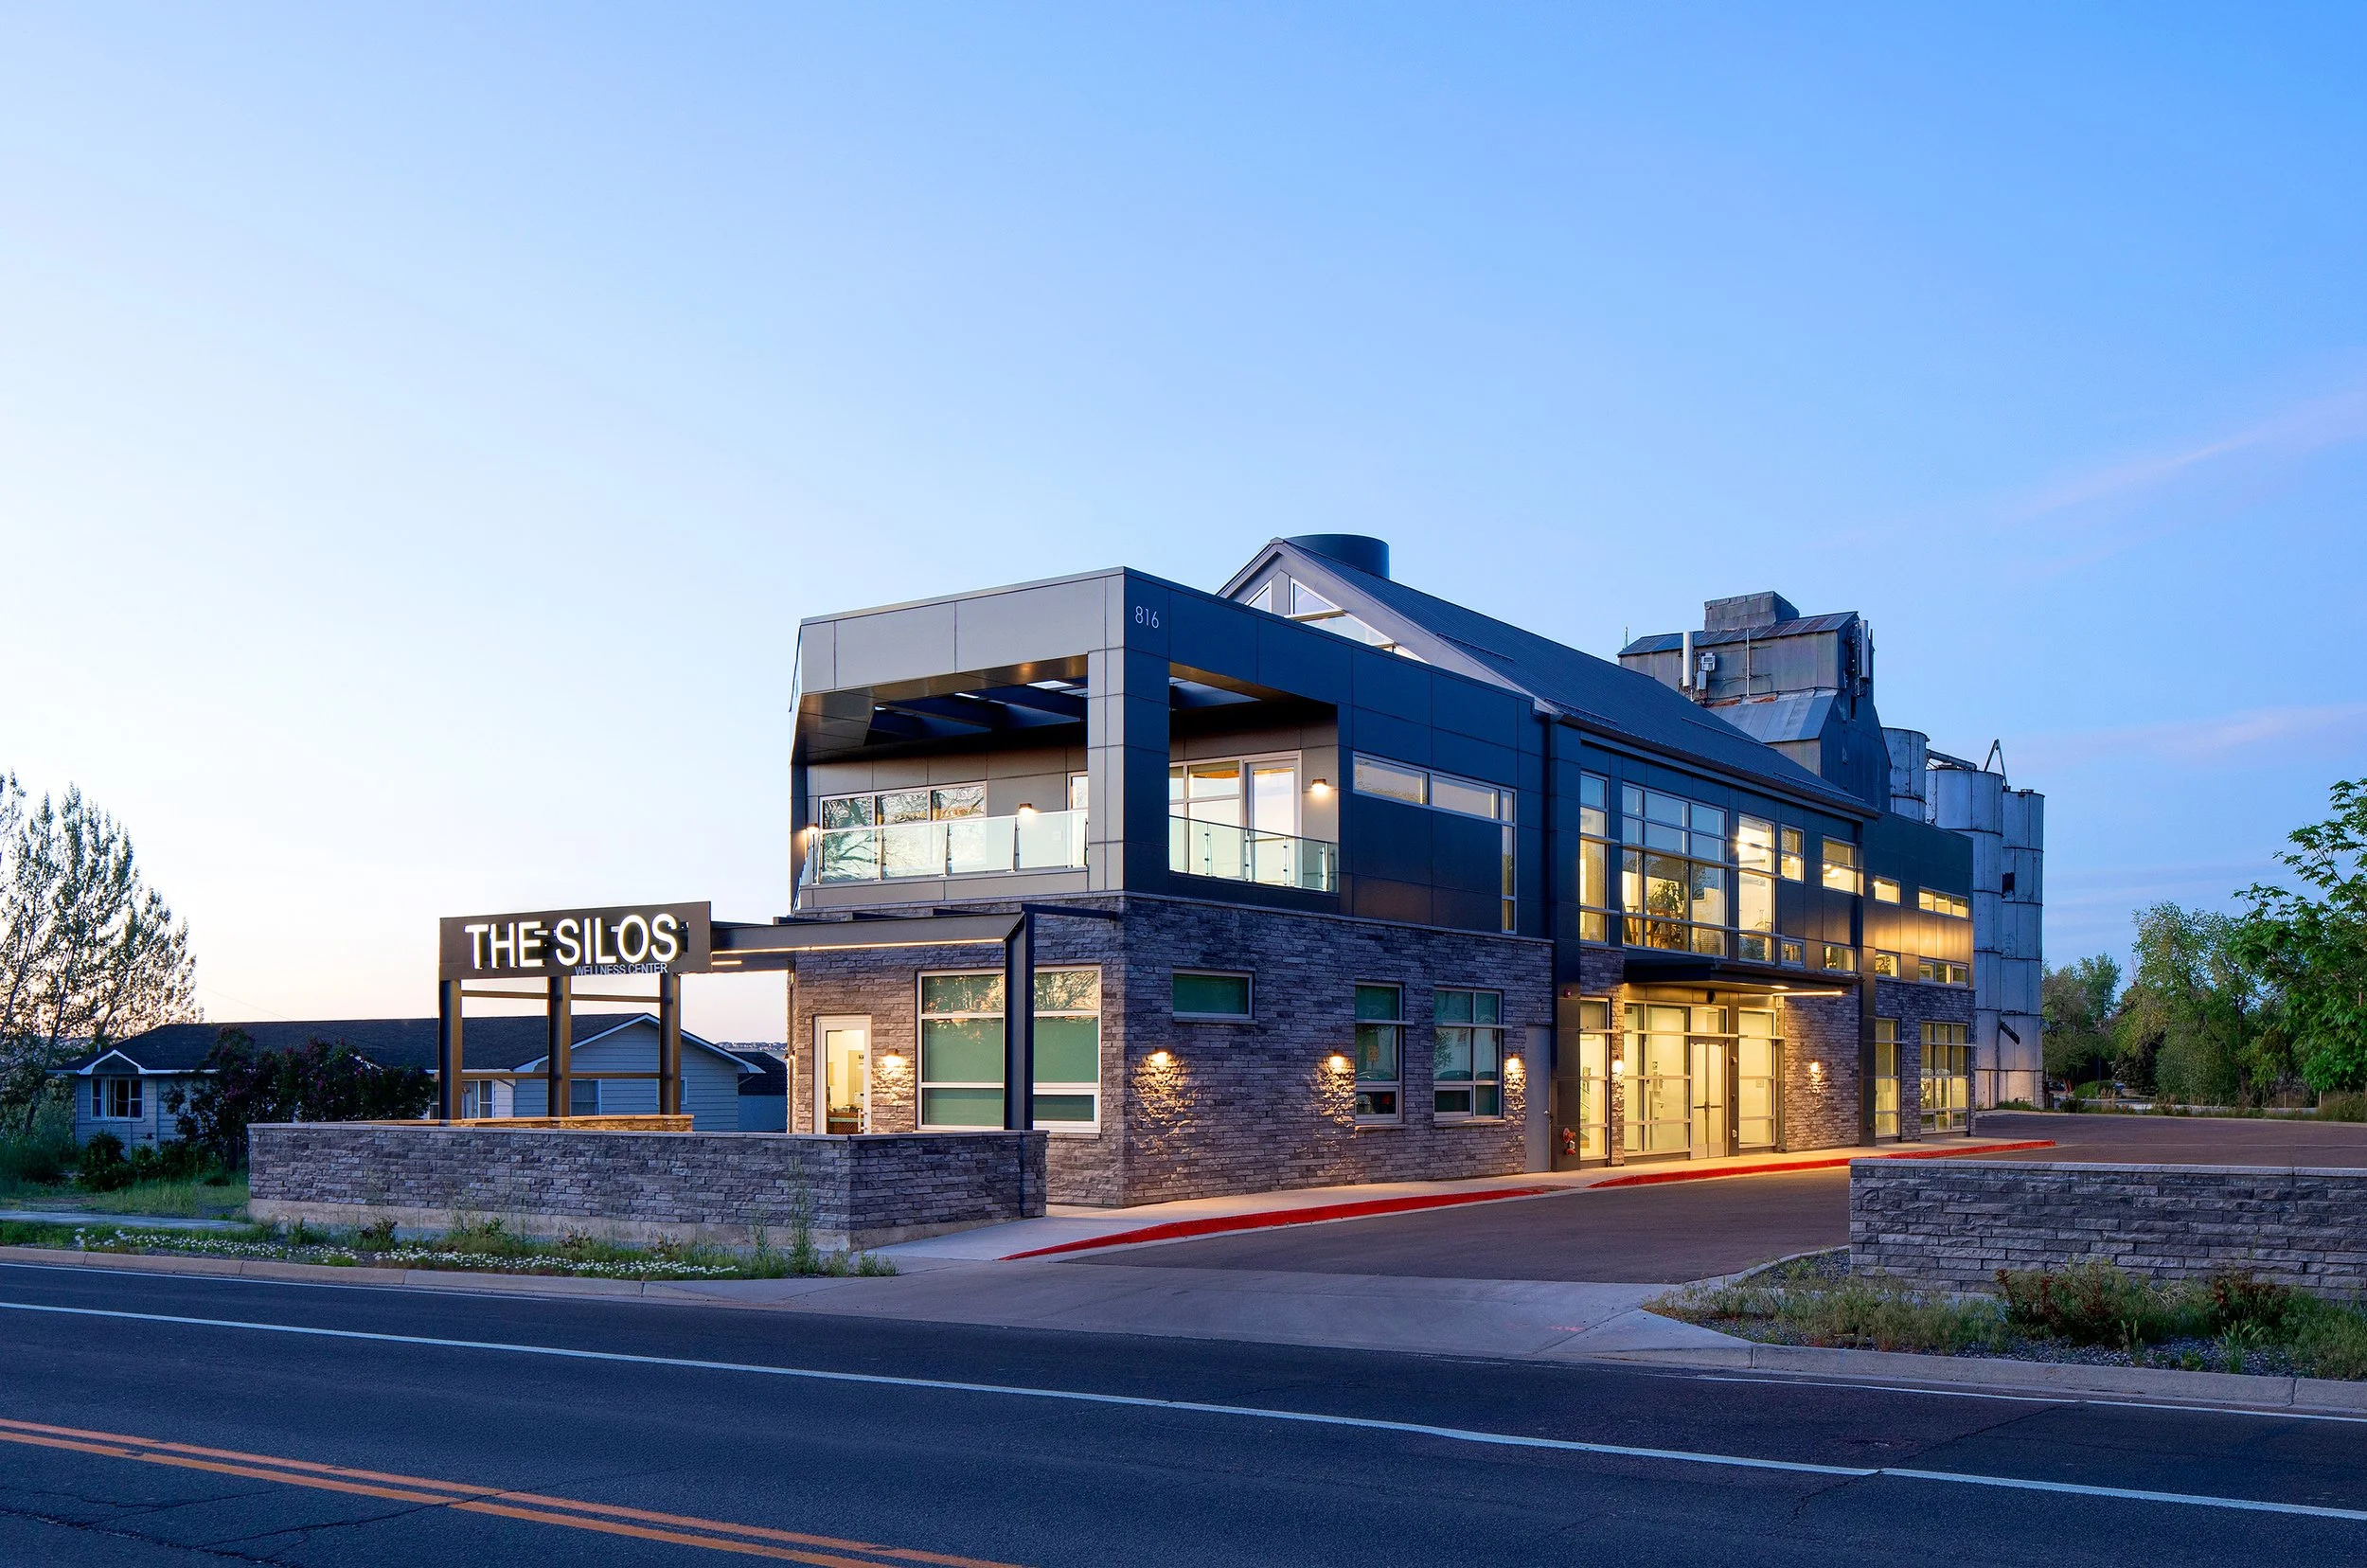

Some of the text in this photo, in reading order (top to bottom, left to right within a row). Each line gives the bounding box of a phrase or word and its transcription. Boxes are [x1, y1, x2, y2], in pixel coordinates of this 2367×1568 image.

[1135, 606, 1160, 629] 816
[464, 913, 679, 970] THE SILOS
[574, 962, 668, 976] WELLNESS CENTER
